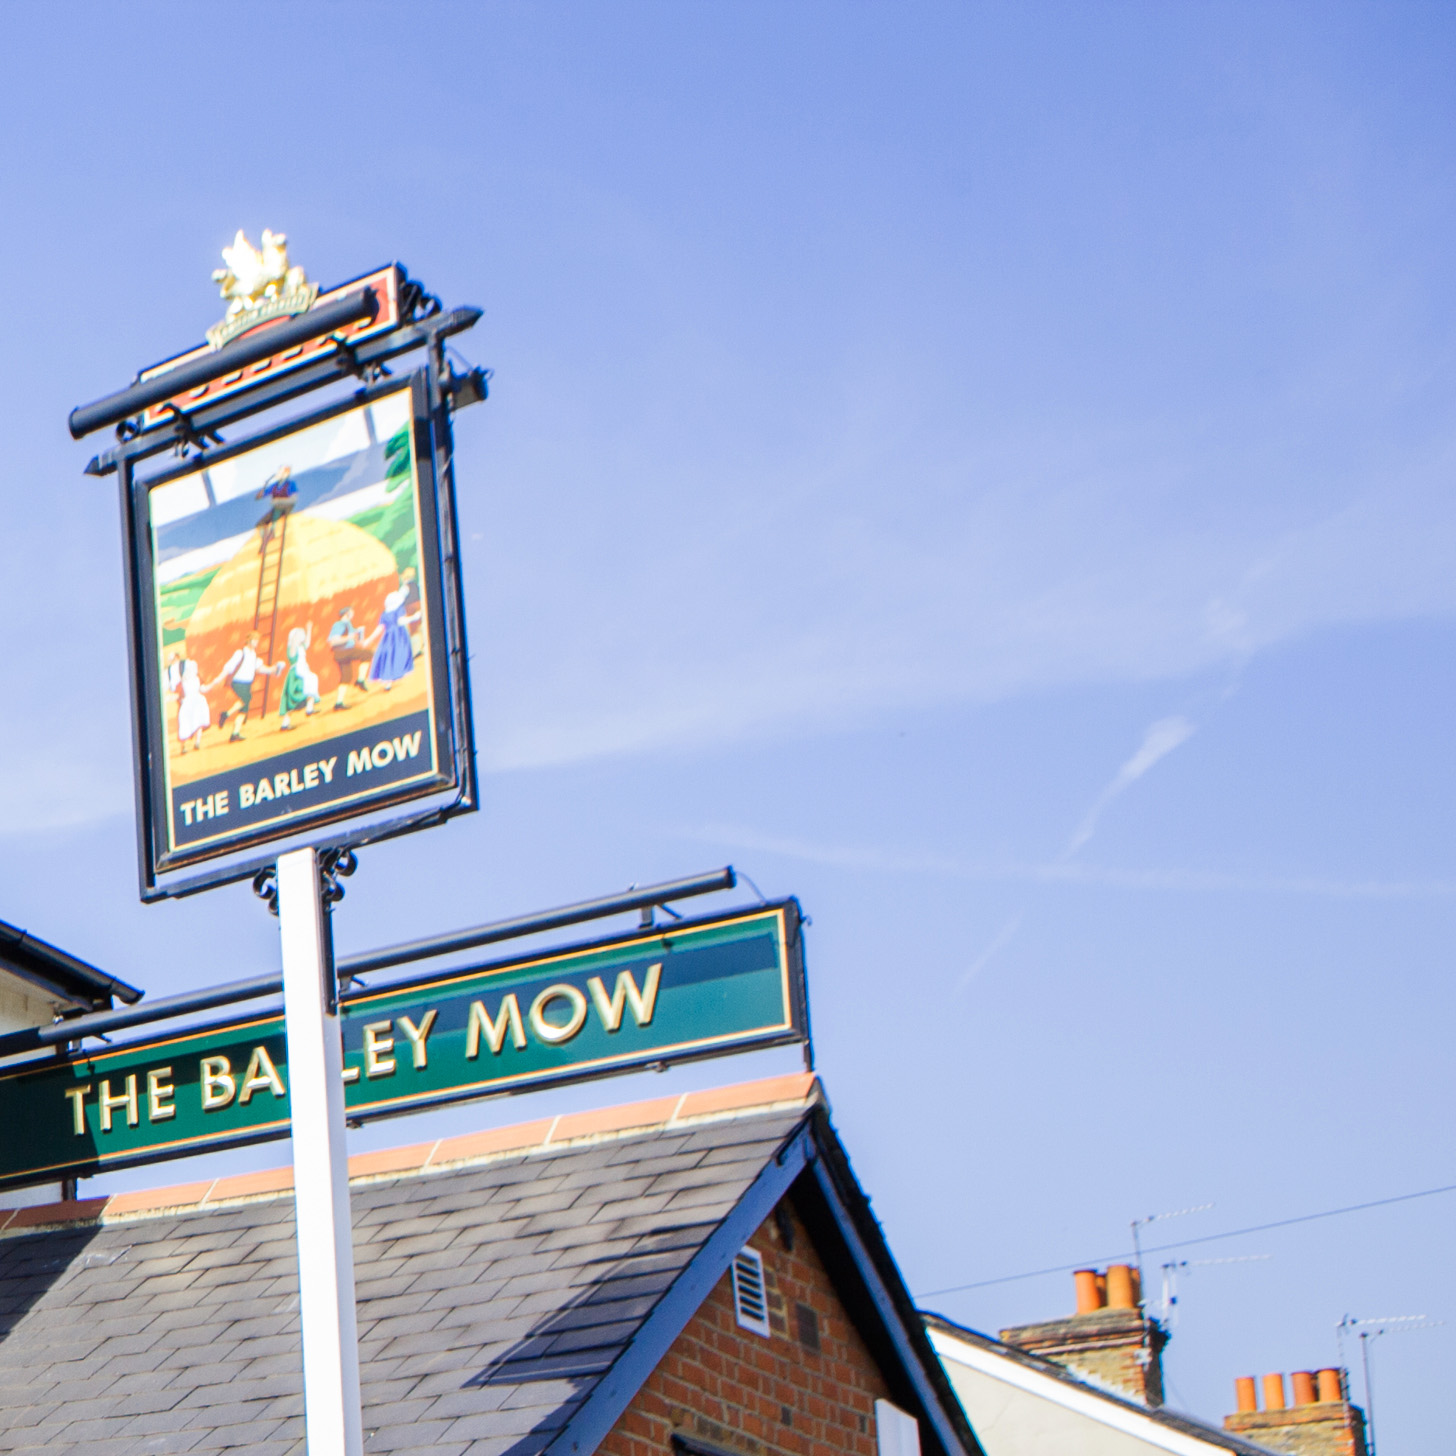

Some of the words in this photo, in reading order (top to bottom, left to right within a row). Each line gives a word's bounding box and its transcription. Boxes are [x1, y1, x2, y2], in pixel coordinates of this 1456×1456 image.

[179, 790, 230, 826] THE
[239, 756, 338, 810] BARLEY
[346, 730, 422, 778] MOW
[64, 1066, 177, 1137] THE
[200, 1008, 438, 1112] BAEY
[465, 962, 662, 1060] MOW
